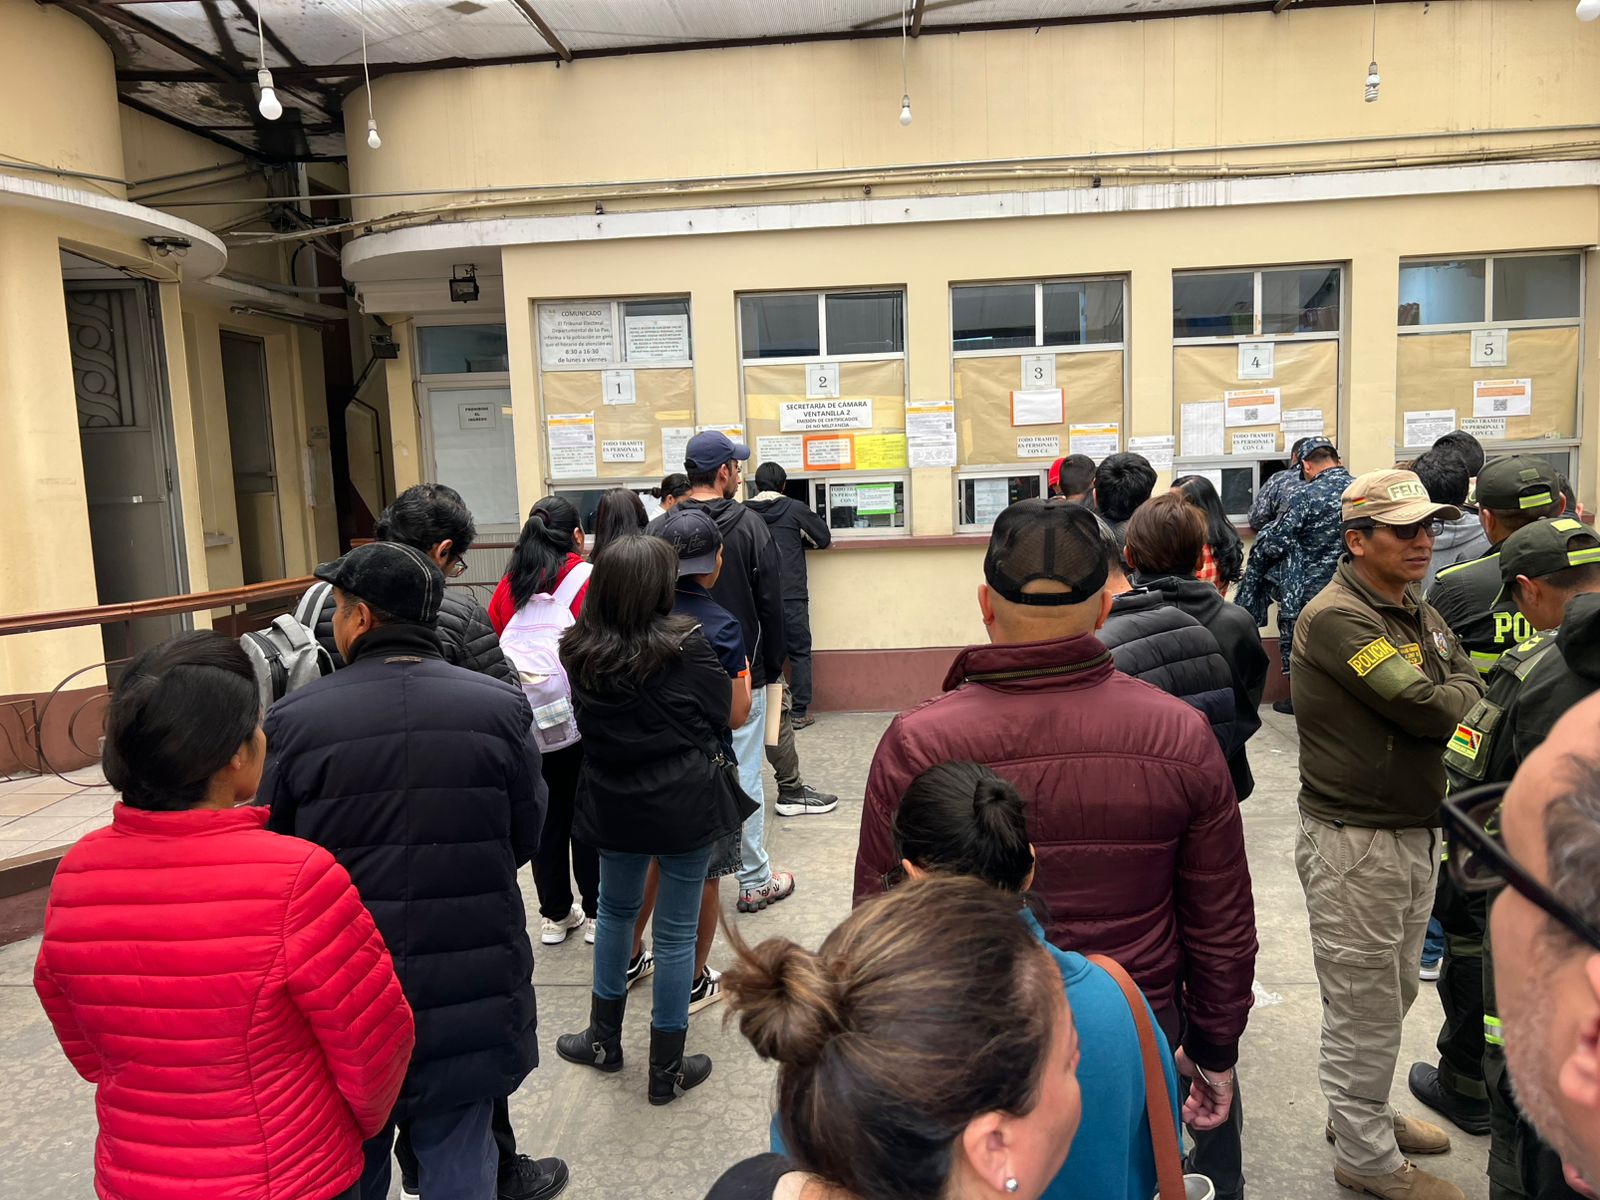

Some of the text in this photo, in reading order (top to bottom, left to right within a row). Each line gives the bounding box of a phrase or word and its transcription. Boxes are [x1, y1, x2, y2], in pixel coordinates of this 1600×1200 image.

[1483, 342, 1494, 356] 5
[1250, 356, 1262, 369] 4
[1034, 367, 1043, 380] 3
[615, 382, 622, 395] 1
[818, 376, 828, 388] 2
[786, 402, 826, 411] SECRETARÍA
[803, 409, 845, 417] VENTANILLA
[1352, 640, 1393, 673] POLICIA
